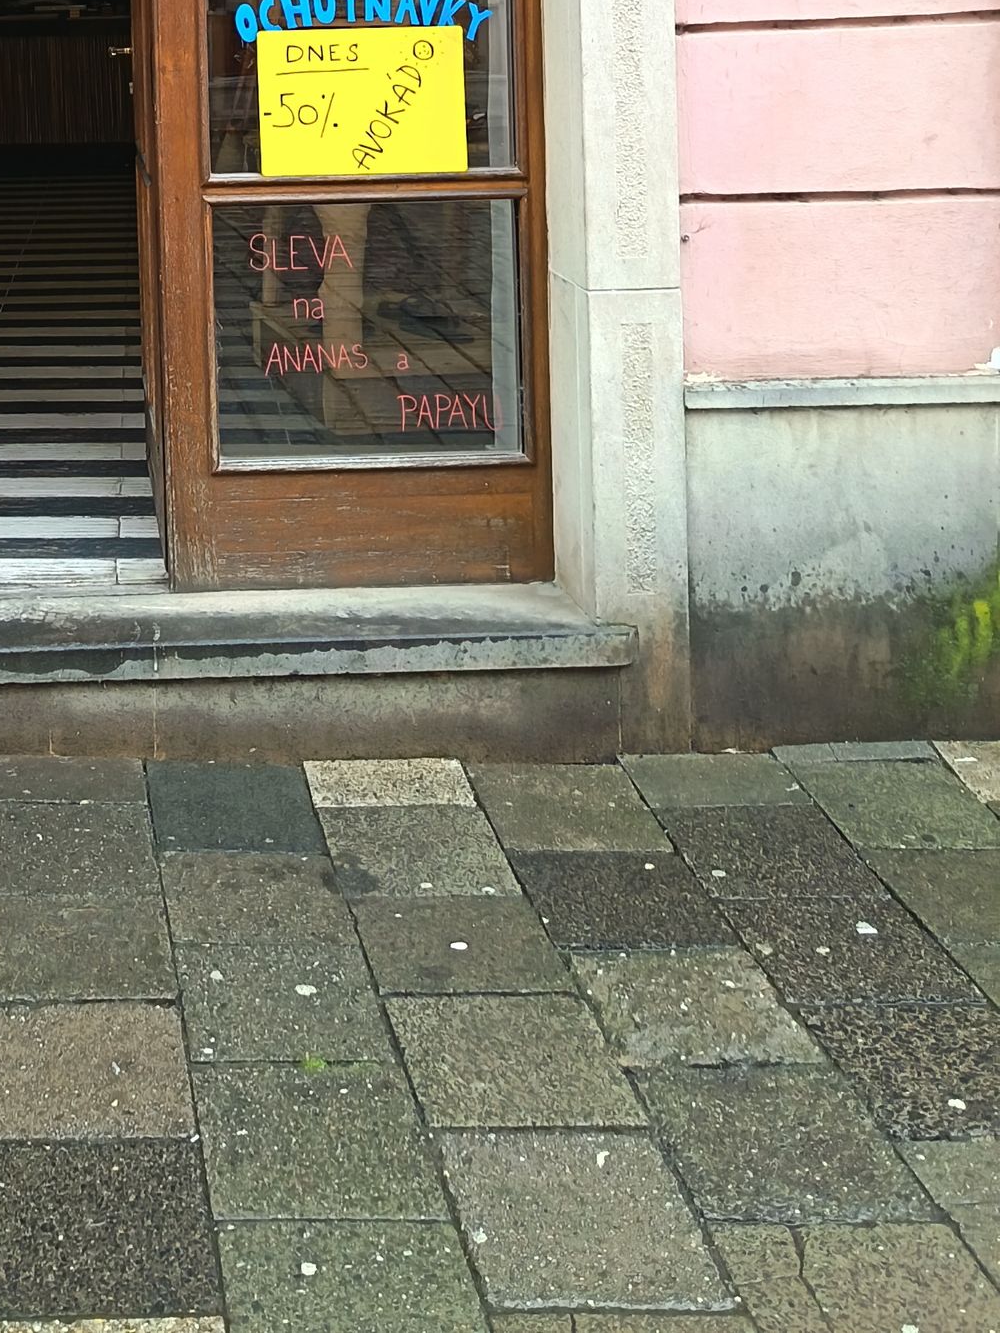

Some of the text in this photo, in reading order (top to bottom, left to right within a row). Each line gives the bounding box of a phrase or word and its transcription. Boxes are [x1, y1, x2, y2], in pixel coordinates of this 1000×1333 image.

[286, 43, 358, 63] DNES
[264, 92, 338, 138] -50%
[249, 233, 353, 271] SLEVA
[292, 297, 325, 319] na
[264, 342, 409, 377] ANANAS a
[397, 394, 503, 432] PAPAYU
